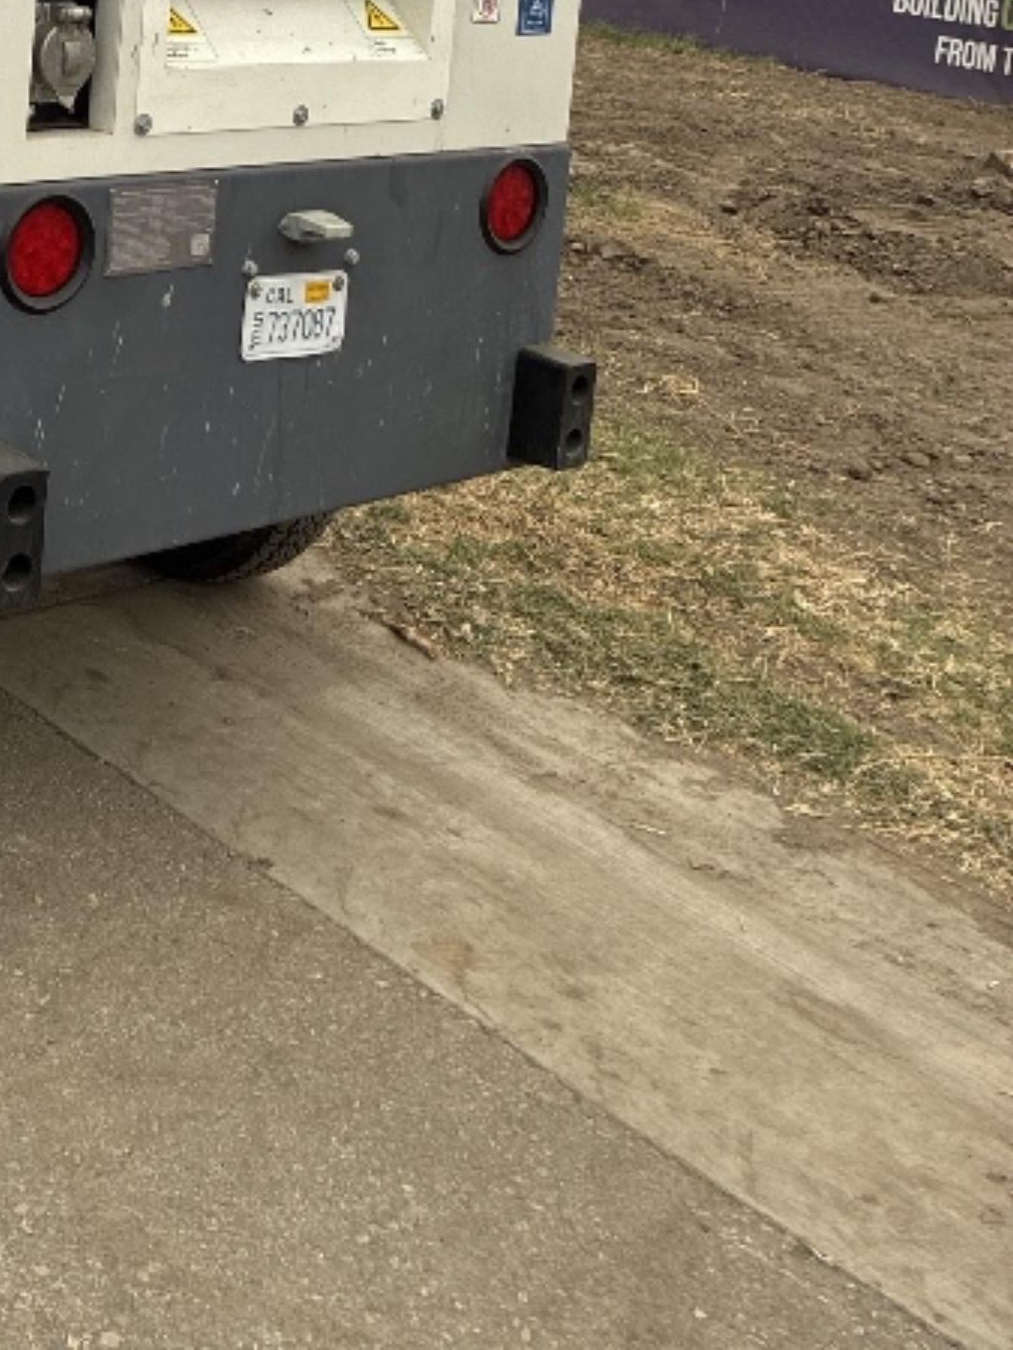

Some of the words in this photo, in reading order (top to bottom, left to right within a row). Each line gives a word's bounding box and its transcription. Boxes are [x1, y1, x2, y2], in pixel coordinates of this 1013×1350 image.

[934, 35, 998, 73] FROM
[265, 287, 294, 304] CAL
[268, 306, 335, 342] 737097
